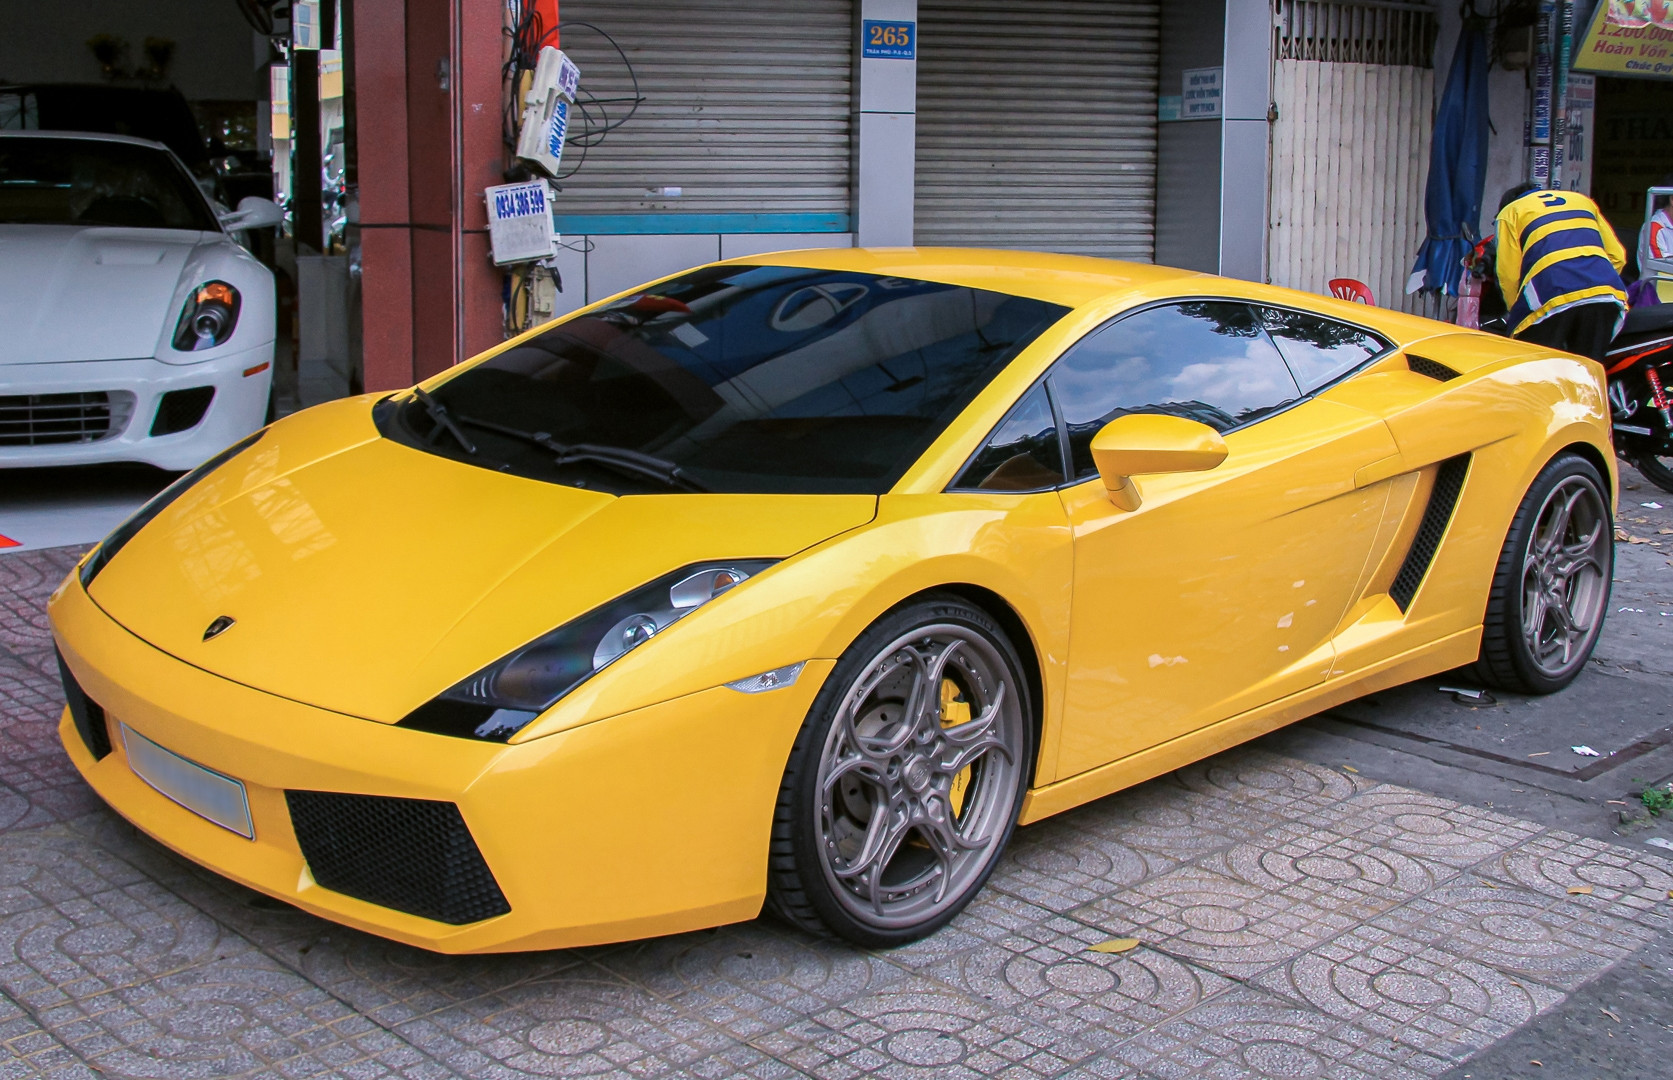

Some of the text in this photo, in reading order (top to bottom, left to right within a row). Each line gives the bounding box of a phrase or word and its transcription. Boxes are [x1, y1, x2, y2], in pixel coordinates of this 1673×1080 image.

[870, 26, 909, 46] 265
[1593, 40, 1669, 58] Hoàn Vốn
[496, 194, 516, 219] 0934
[530, 189, 545, 214] 599
